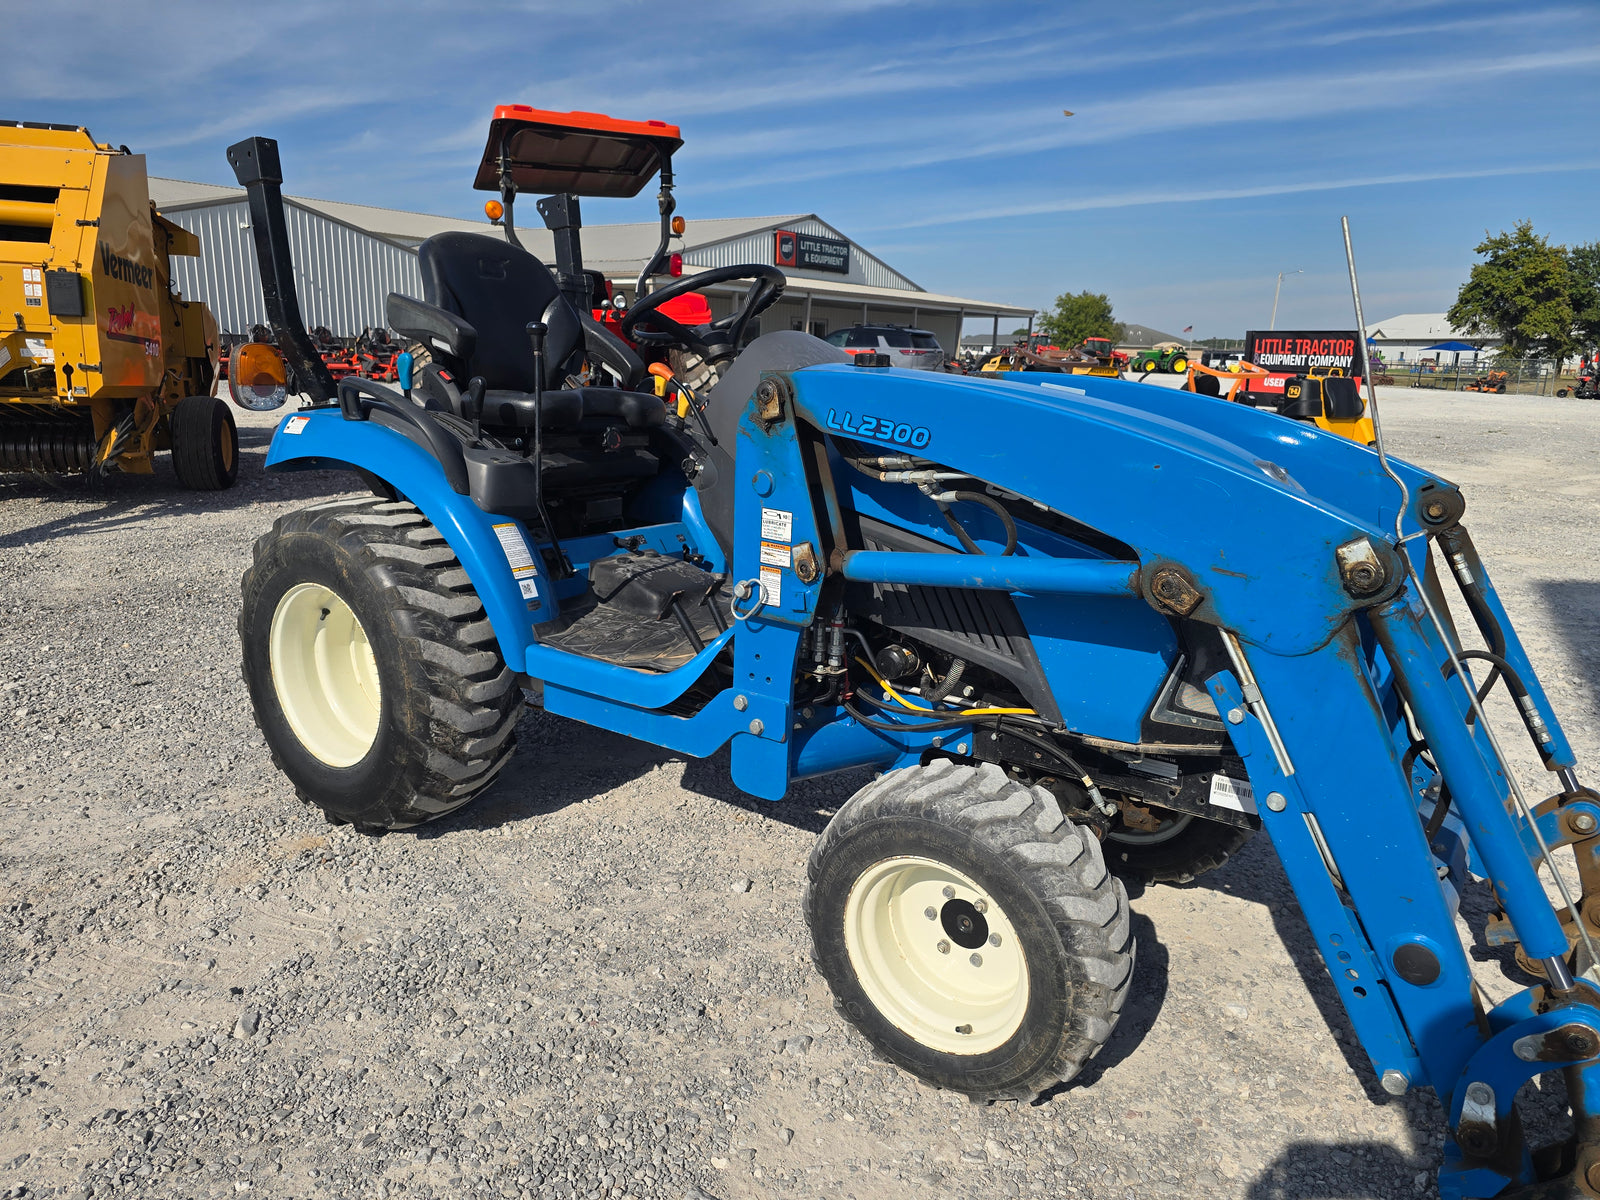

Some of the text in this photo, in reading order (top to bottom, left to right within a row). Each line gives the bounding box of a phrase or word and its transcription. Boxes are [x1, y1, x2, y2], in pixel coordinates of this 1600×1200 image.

[800, 241, 820, 252] LITTLE
[822, 243, 848, 256] TRACTOR
[99, 240, 153, 290] Vermeer
[804, 253, 844, 266] & EQUIPMENT
[1254, 338, 1355, 356] LITTLE TRACTOR
[1308, 355, 1353, 368] COMPANY
[1264, 378, 1285, 387] USED
[826, 408, 931, 450] LL2300
